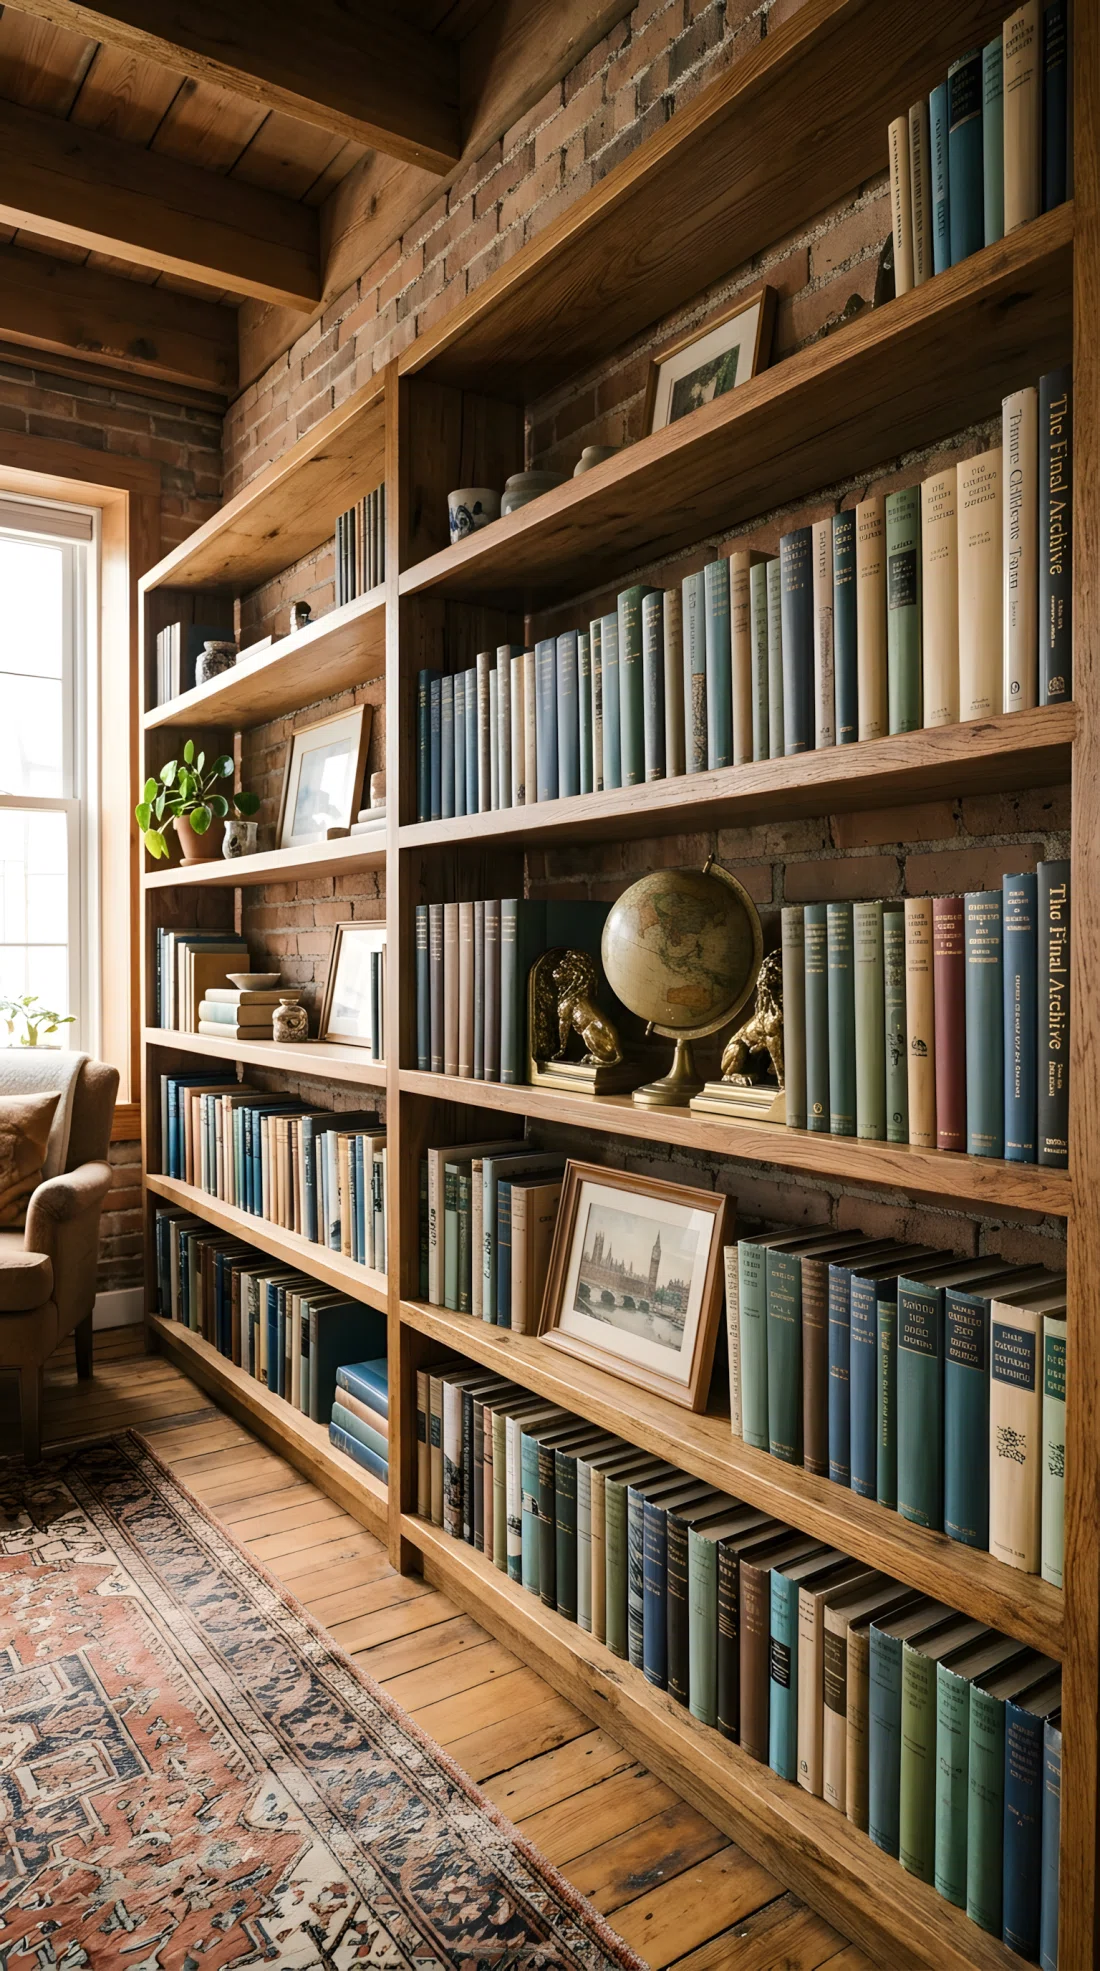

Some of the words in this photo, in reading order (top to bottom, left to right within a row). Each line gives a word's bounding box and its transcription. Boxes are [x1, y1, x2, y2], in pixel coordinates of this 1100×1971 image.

[1049, 393, 1068, 435] The
[1049, 438, 1069, 493] Final
[1049, 500, 1068, 575] Archive
[1049, 884, 1067, 920] The
[1049, 926, 1068, 973] Final
[1048, 978, 1066, 1050] Archive
